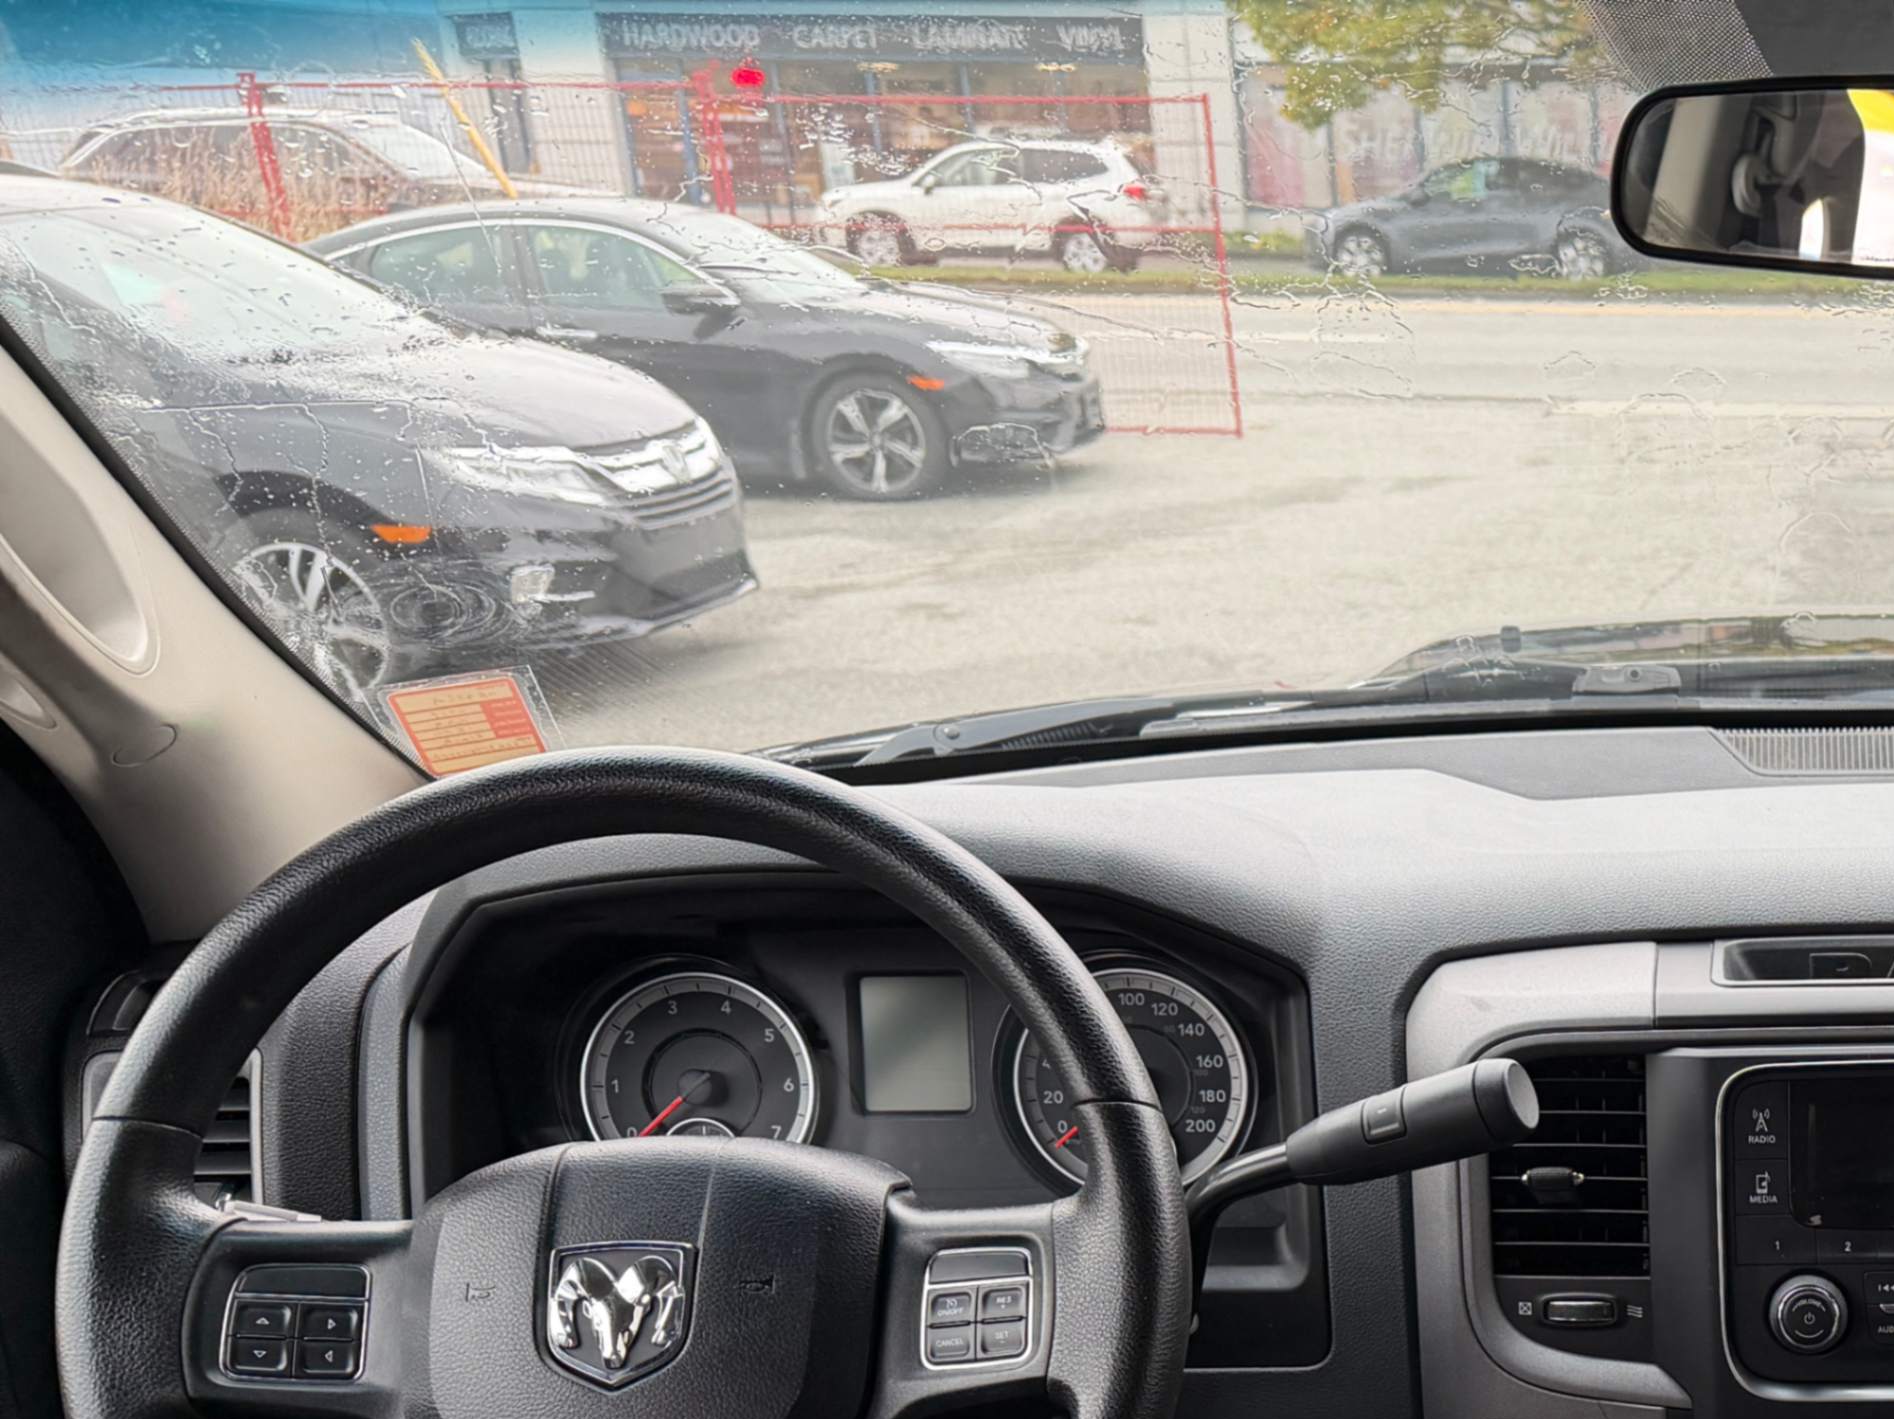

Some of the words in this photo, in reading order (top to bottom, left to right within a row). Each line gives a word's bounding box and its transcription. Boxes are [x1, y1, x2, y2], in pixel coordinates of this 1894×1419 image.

[624, 22, 761, 48] HARDWOOD
[793, 24, 878, 49] CARPET
[1118, 993, 1145, 1006] 100
[668, 1001, 678, 1015] 3
[720, 1001, 732, 1015] 4
[1152, 1002, 1178, 1016] 120
[764, 1028, 775, 1042] 5
[1178, 1023, 1205, 1036] 140
[624, 1031, 635, 1044] 2
[1196, 1055, 1223, 1068] 160
[611, 1079, 620, 1093] 1
[783, 1078, 794, 1092] 6
[1043, 1091, 1064, 1104] 20
[1200, 1090, 1226, 1103] 180
[771, 1126, 782, 1139] 7
[1185, 1119, 1216, 1133] 200
[1748, 1134, 1776, 1144] RADIO
[1749, 1194, 1778, 1204] MEDIA
[1775, 1241, 1781, 1251] 1
[1844, 1242, 1852, 1252] 2
